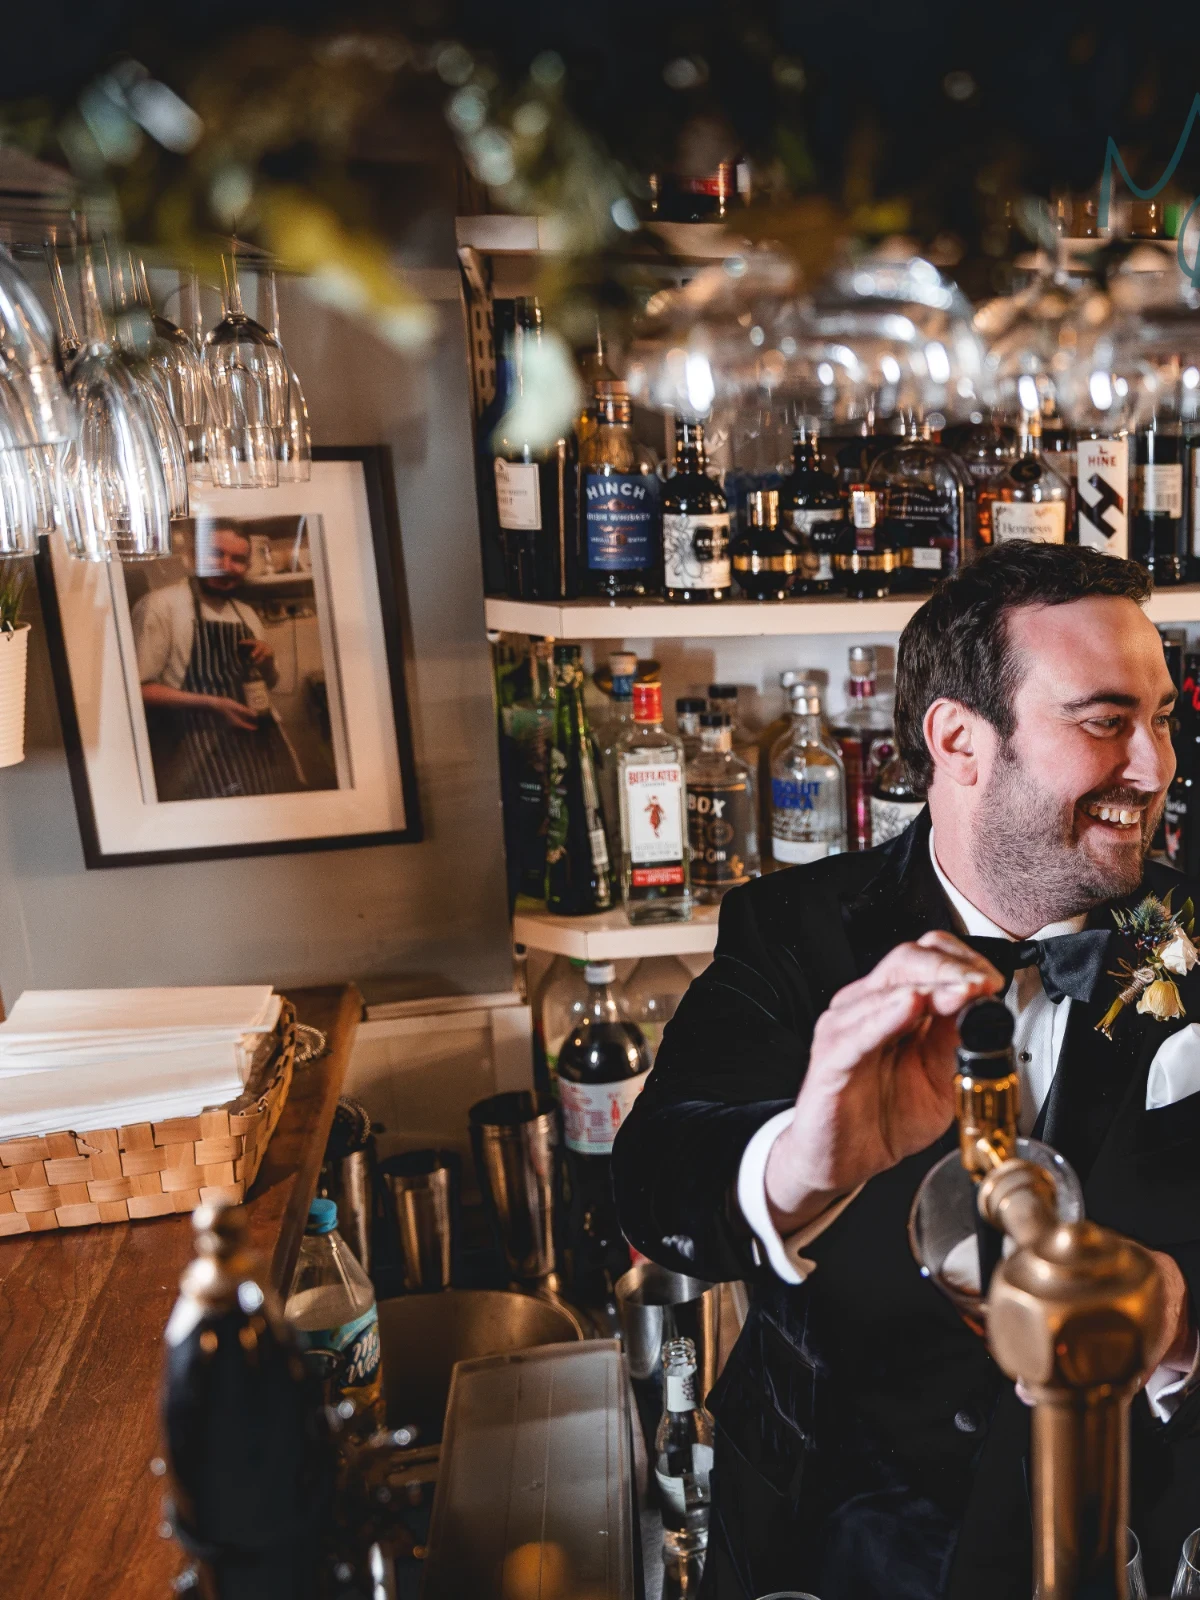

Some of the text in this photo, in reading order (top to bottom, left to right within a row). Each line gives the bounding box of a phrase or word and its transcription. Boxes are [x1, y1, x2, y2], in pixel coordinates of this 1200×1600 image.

[1087, 455, 1117, 468] HINE
[586, 481, 646, 501] HINCH
[628, 769, 680, 785] BEEFEATER
